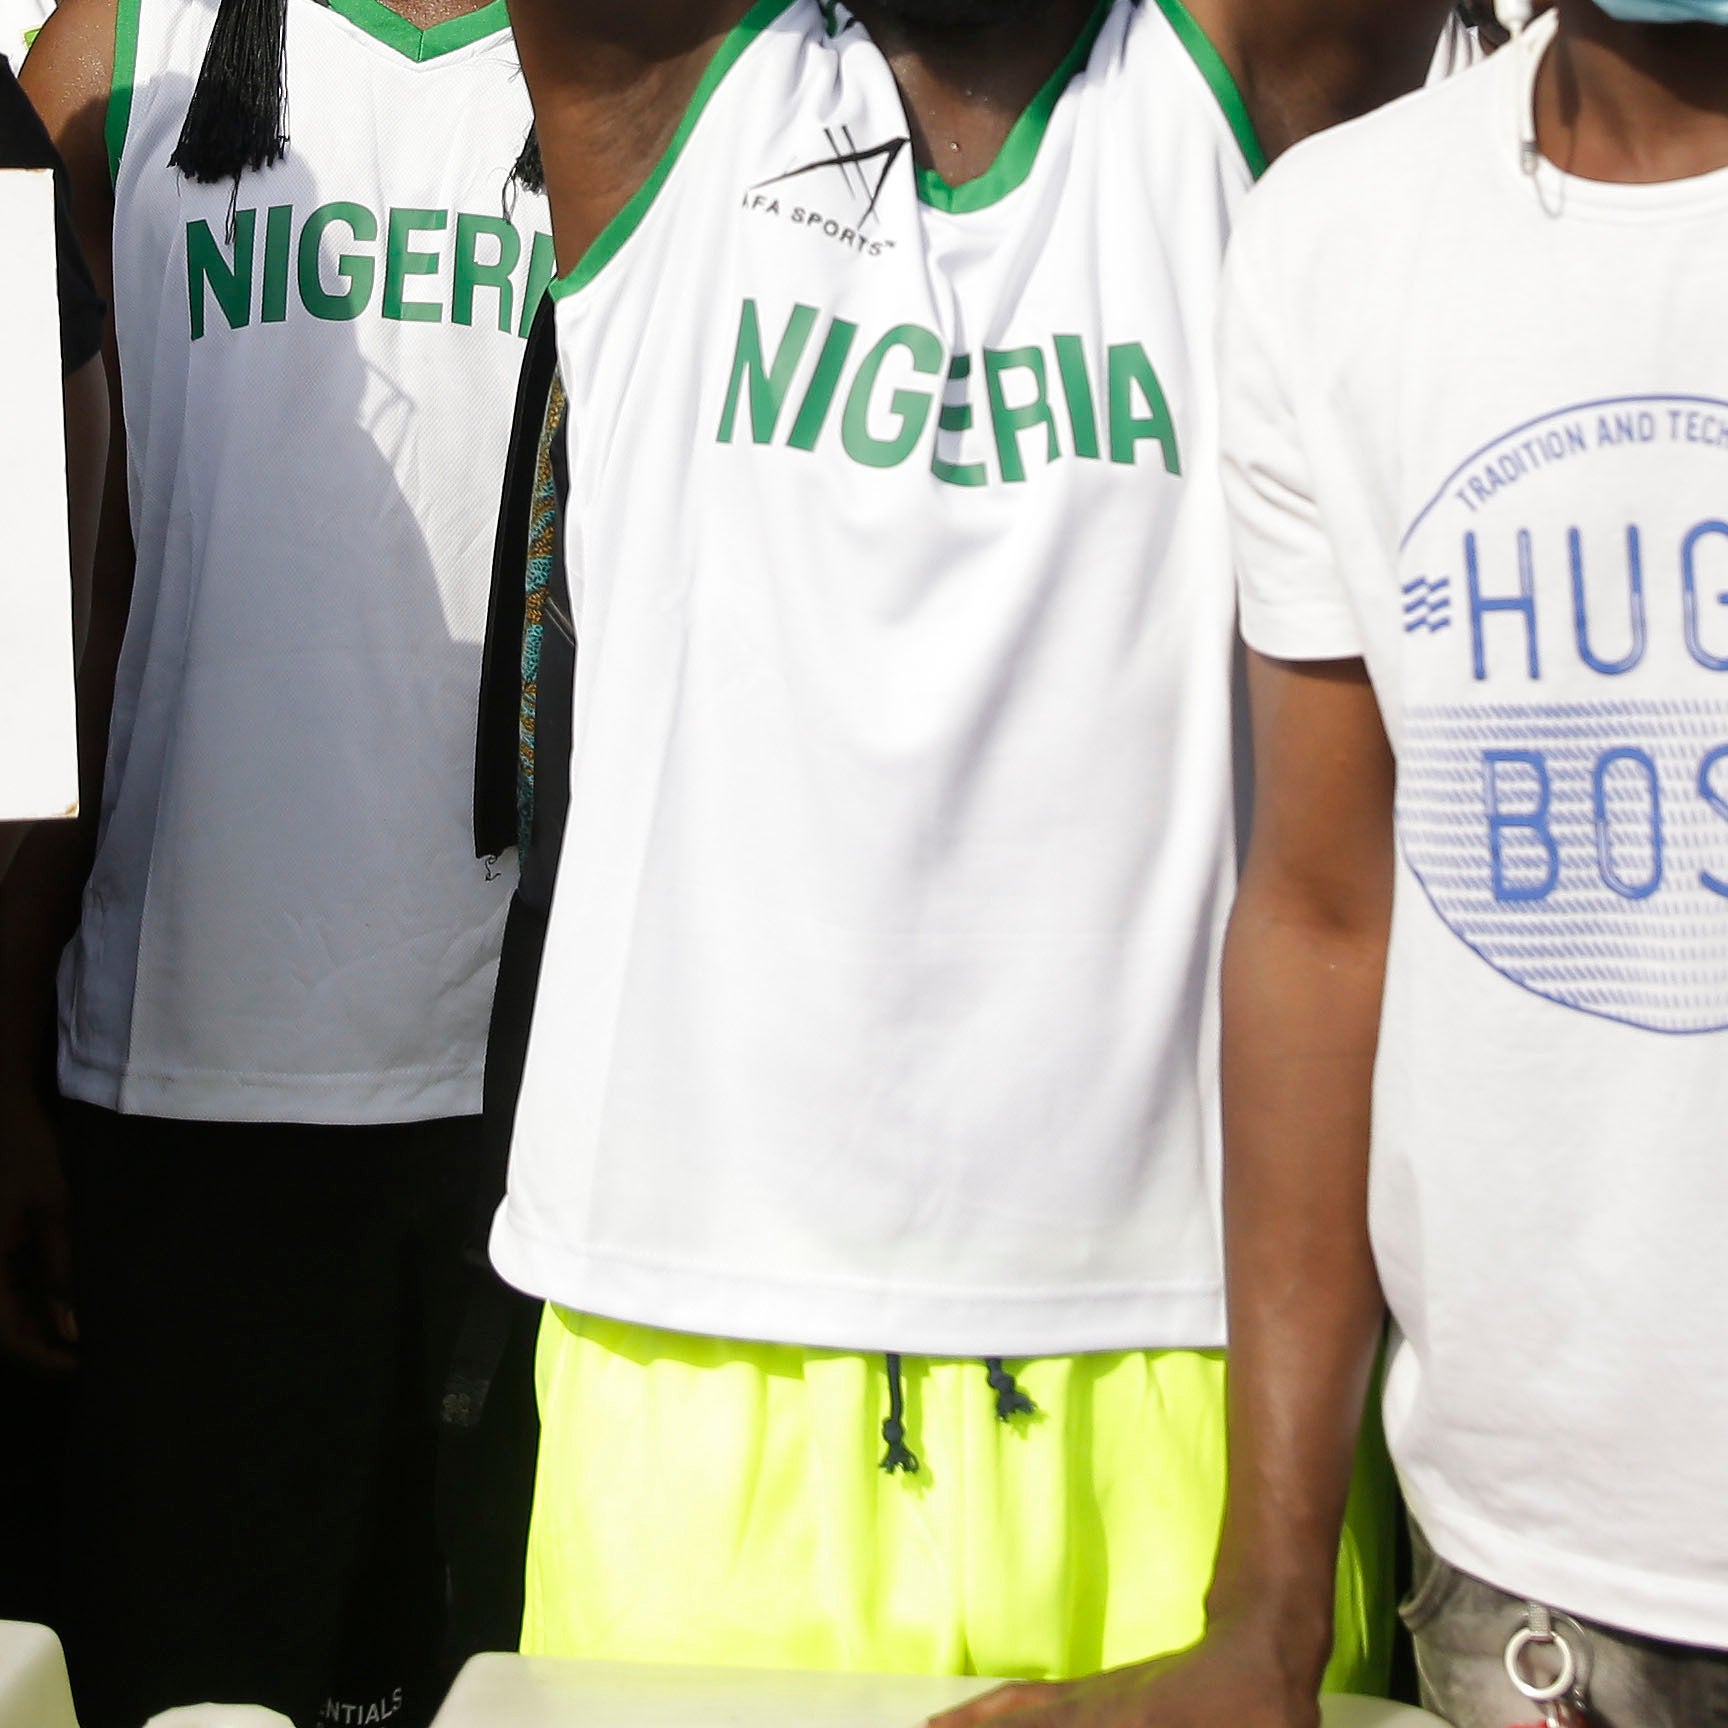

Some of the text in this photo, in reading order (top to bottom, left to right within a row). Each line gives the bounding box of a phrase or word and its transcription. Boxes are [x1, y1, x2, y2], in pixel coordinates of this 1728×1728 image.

[185, 201, 558, 341] NIGERI
[715, 298, 1183, 488] NIGERIA
[1456, 420, 1588, 512] TRADITION
[1596, 410, 1657, 447] AND
